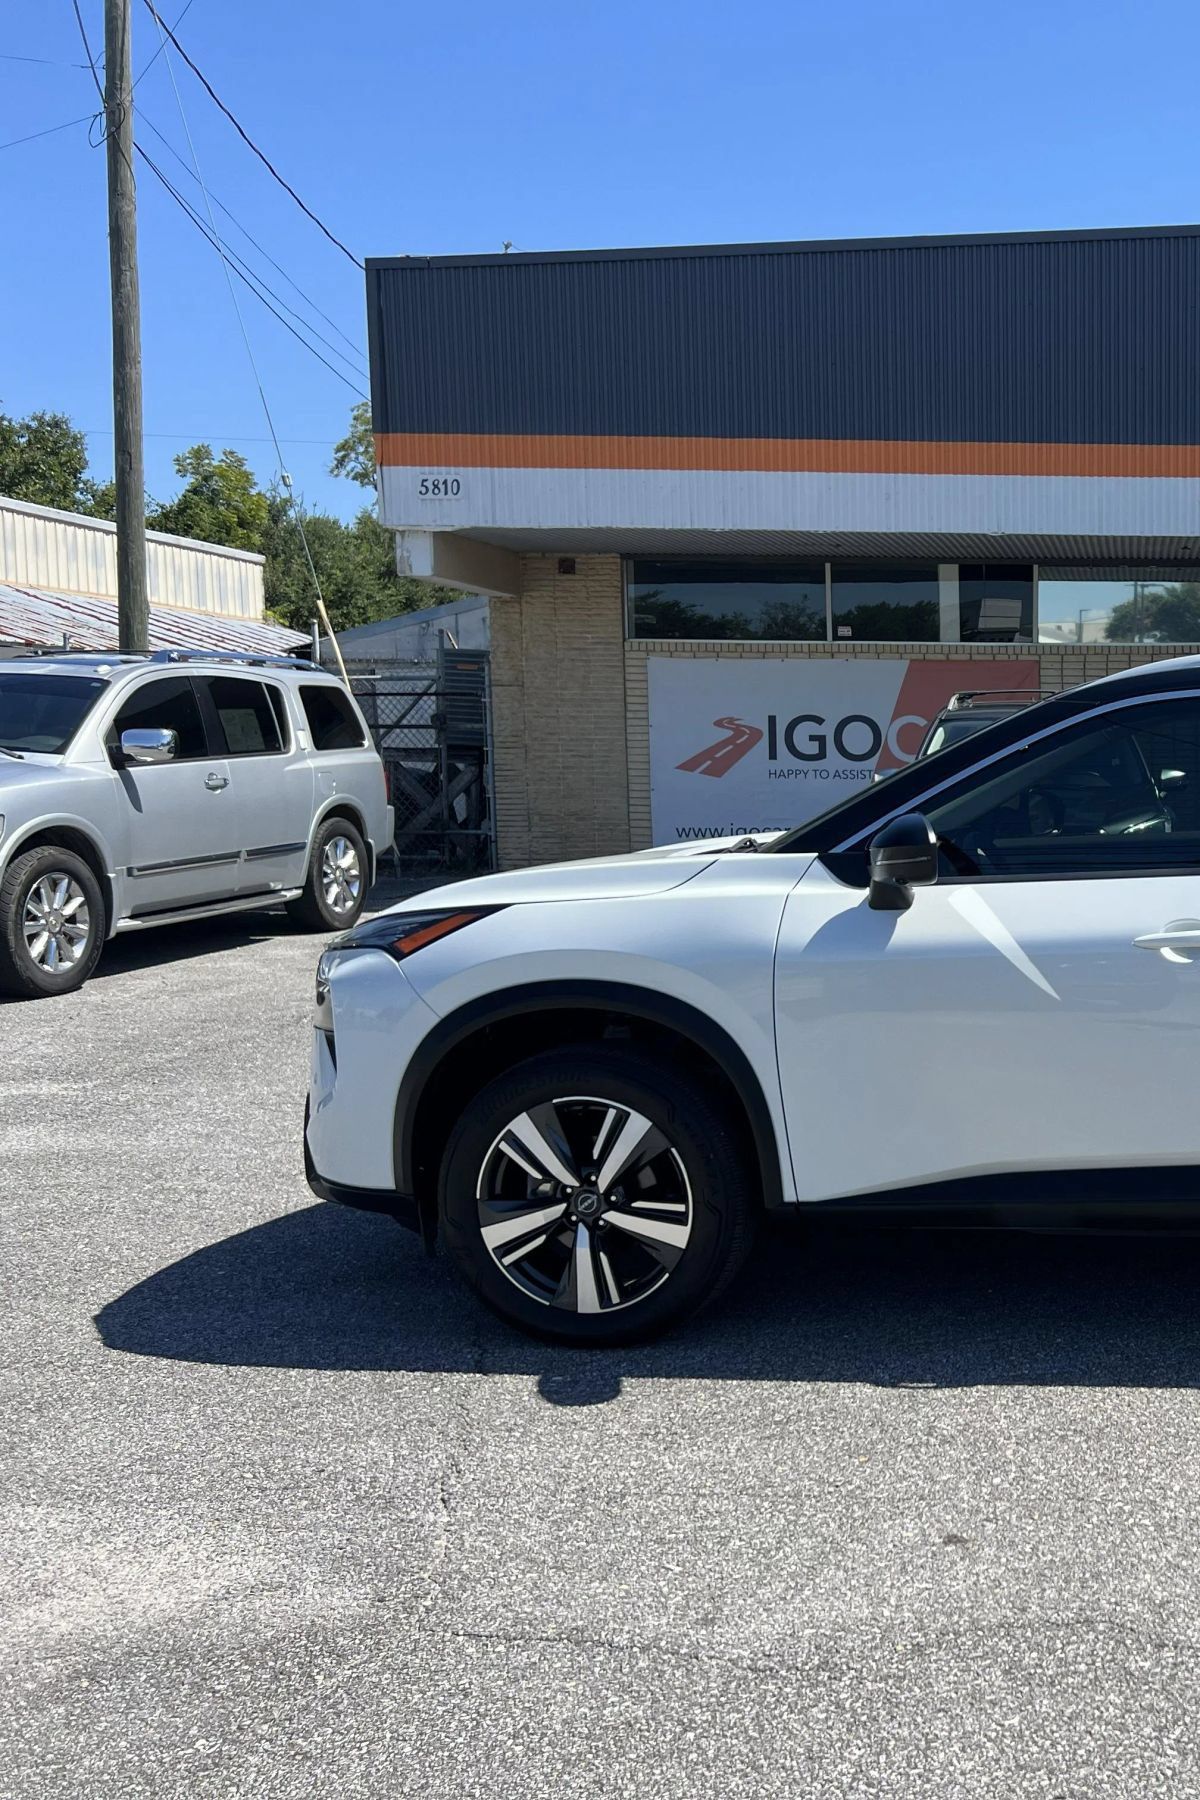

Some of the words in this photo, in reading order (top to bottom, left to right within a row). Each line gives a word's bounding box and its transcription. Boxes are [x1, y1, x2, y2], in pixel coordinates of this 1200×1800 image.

[418, 478, 461, 496] 5810
[768, 769, 810, 780] HAPPY
[812, 769, 830, 780] TO
[833, 769, 874, 780] ASSIST
